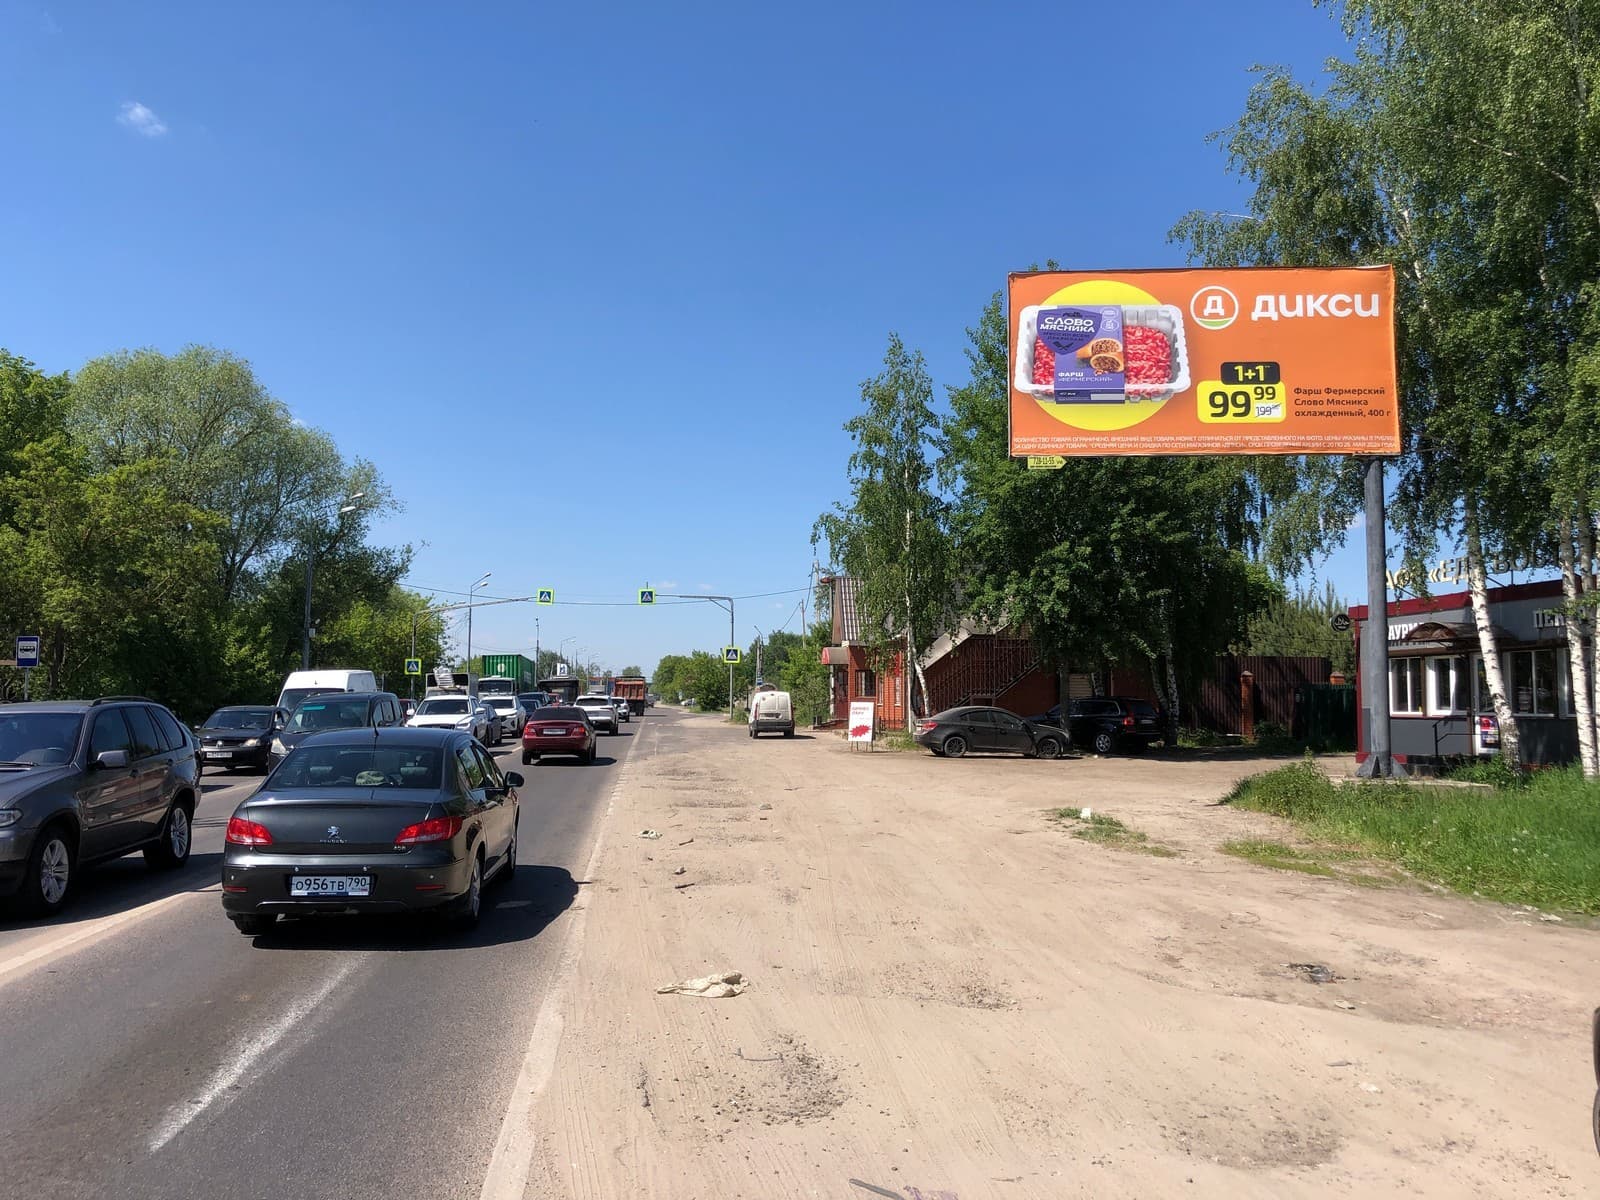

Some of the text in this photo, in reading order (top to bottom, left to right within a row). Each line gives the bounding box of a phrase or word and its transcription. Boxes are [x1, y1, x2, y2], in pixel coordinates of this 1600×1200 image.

[1044, 316, 1094, 327] СЛОВО
[1040, 323, 1096, 334] МЯСНИКА
[1294, 386, 1385, 396] Фарш Фермерский
[1209, 386, 1276, 418] 99 99
[1294, 398, 1369, 406] Слово Мясника
[1367, 409, 1385, 417] 400
[295, 878, 345, 891] О956ТВ
[348, 878, 367, 888] 790
